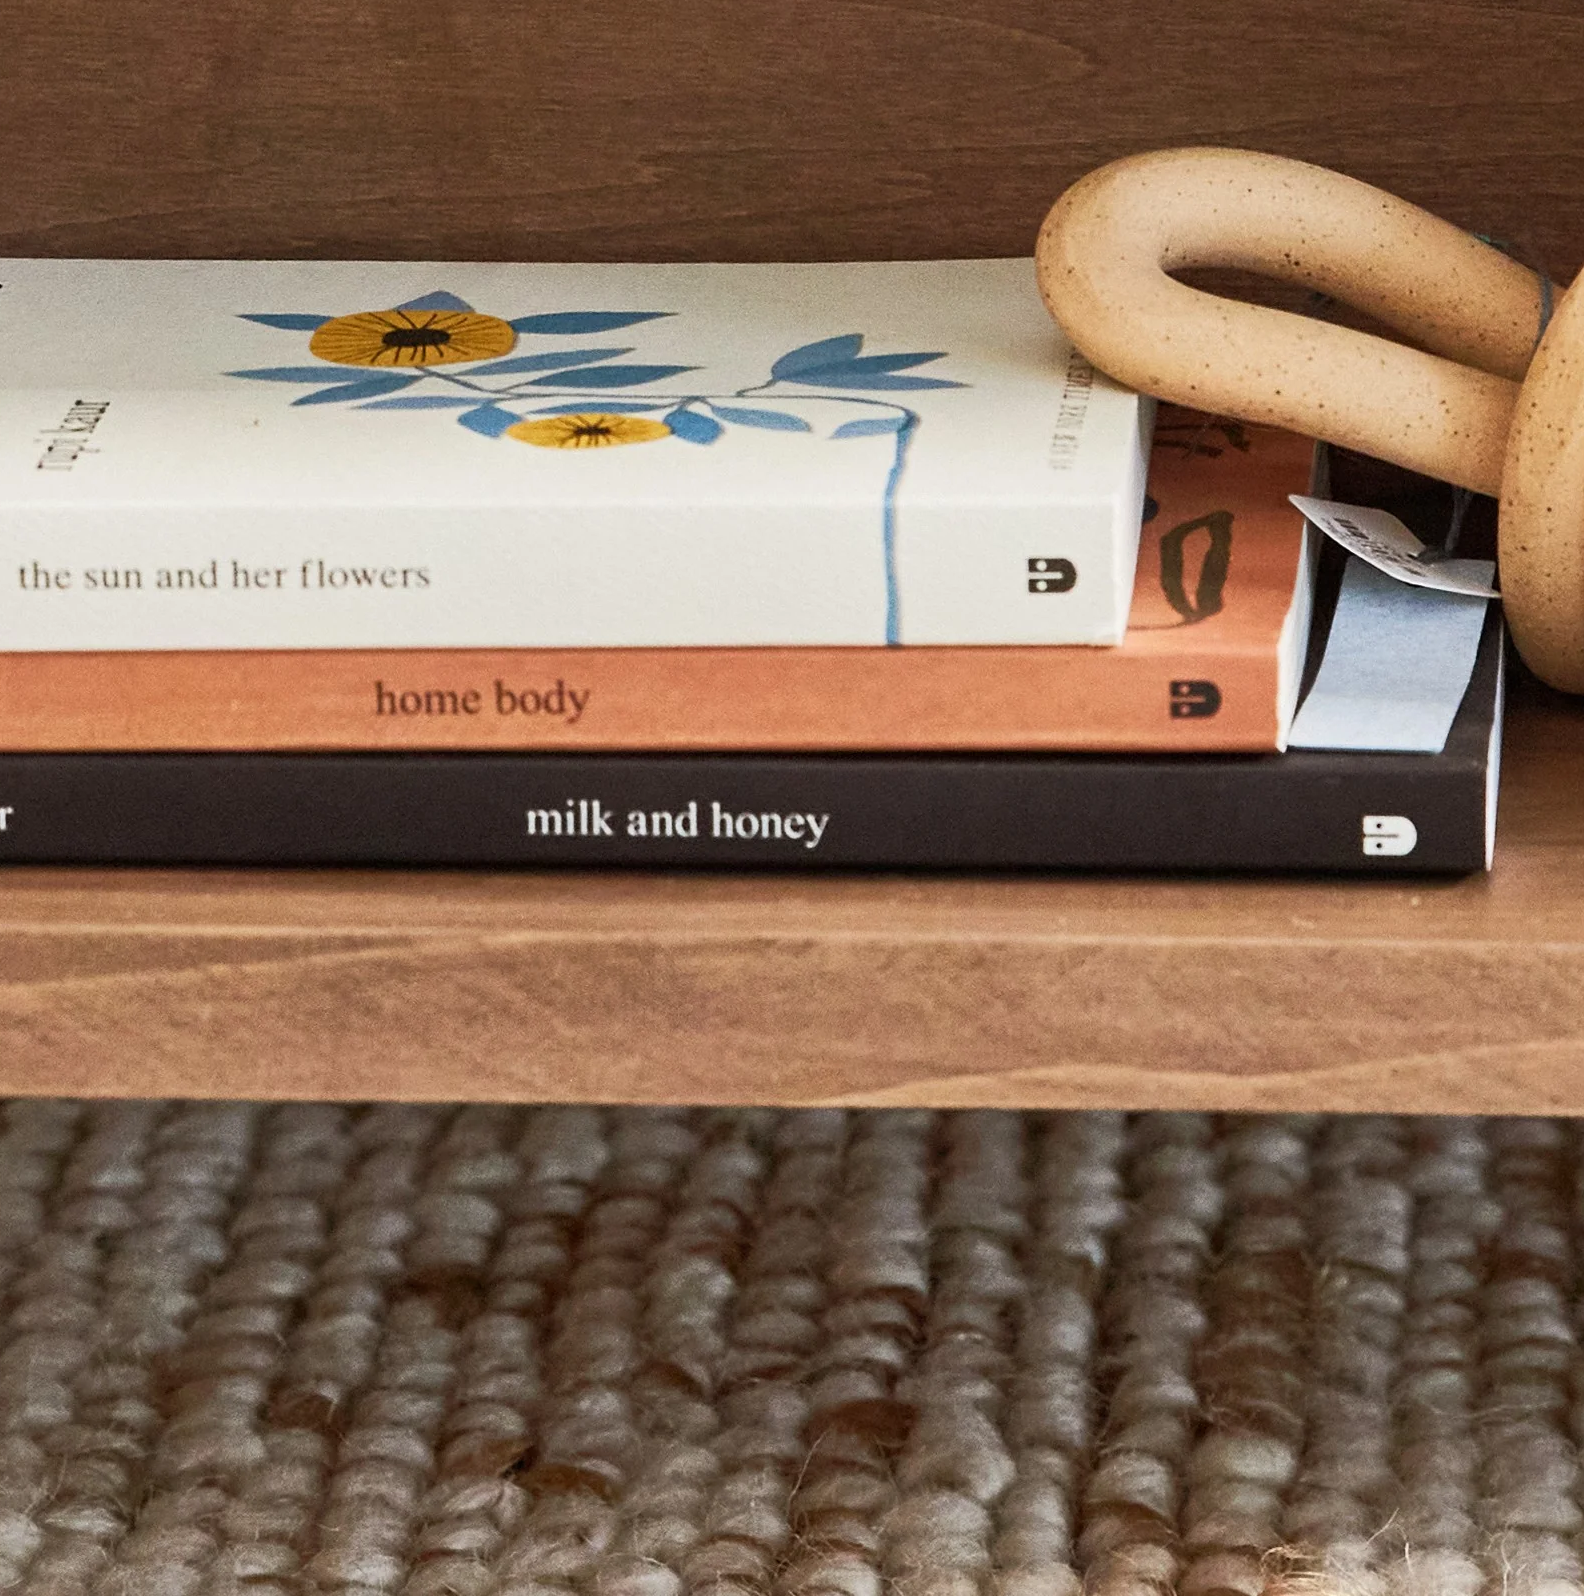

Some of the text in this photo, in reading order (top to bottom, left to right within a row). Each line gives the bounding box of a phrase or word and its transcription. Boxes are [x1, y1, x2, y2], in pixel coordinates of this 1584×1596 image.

[17, 559, 431, 590] the sun and her flowers
[374, 679, 591, 724] home body
[526, 798, 830, 849] milk and honey
